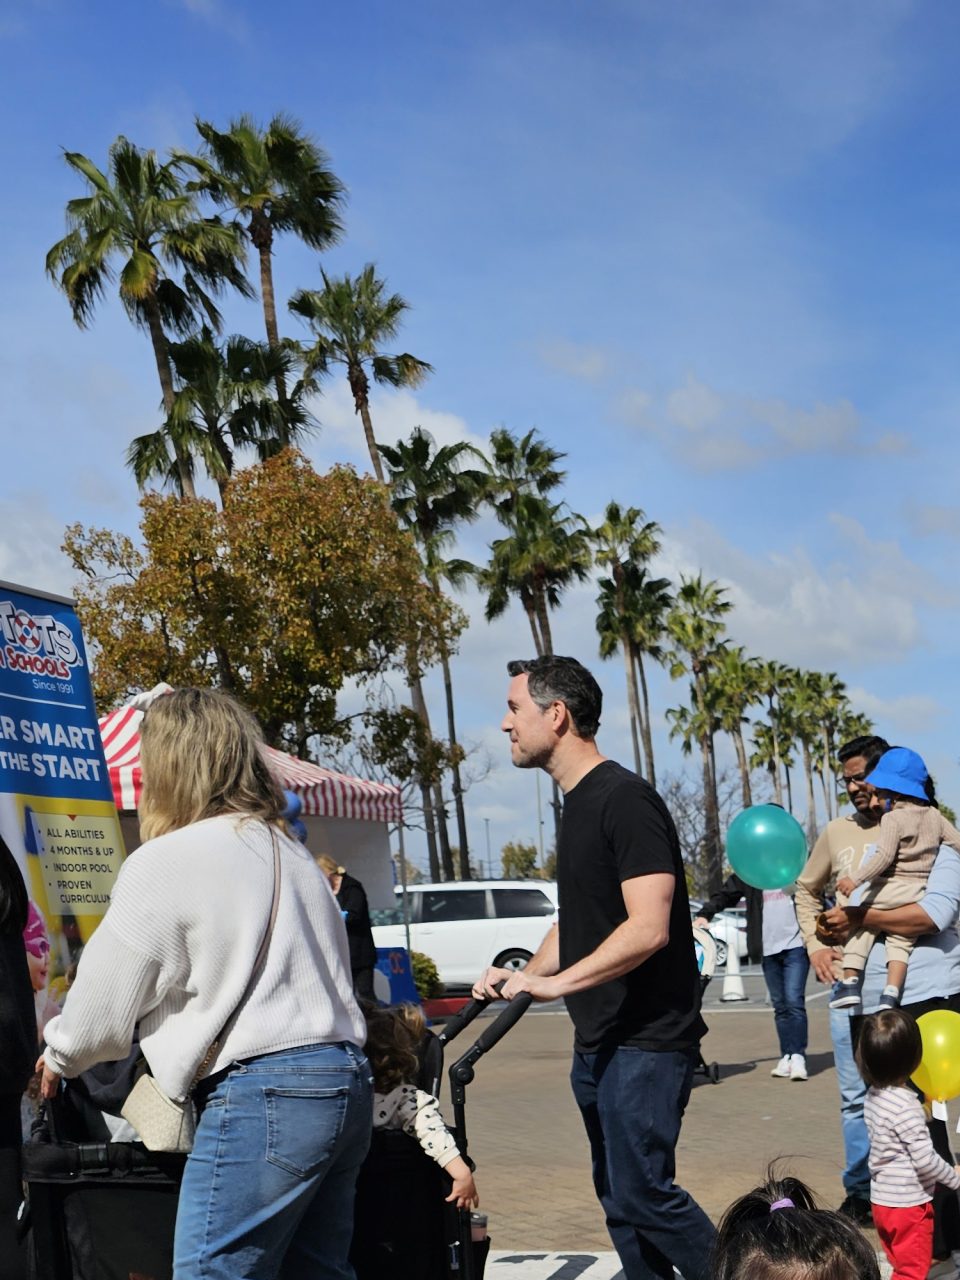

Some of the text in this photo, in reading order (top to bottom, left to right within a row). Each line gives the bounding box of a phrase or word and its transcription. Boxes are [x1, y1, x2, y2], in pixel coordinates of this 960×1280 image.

[6, 647, 70, 679] SCHOOLS
[32, 679, 74, 694] Since 1991
[20, 719, 95, 751] SMART
[0, 751, 100, 782] THE START
[47, 828, 105, 840] ALL ABILITIES
[50, 846, 114, 856] 4 MONTHS & UP
[53, 863, 113, 873] INDOOR POOL
[57, 880, 92, 890] PROVEN
